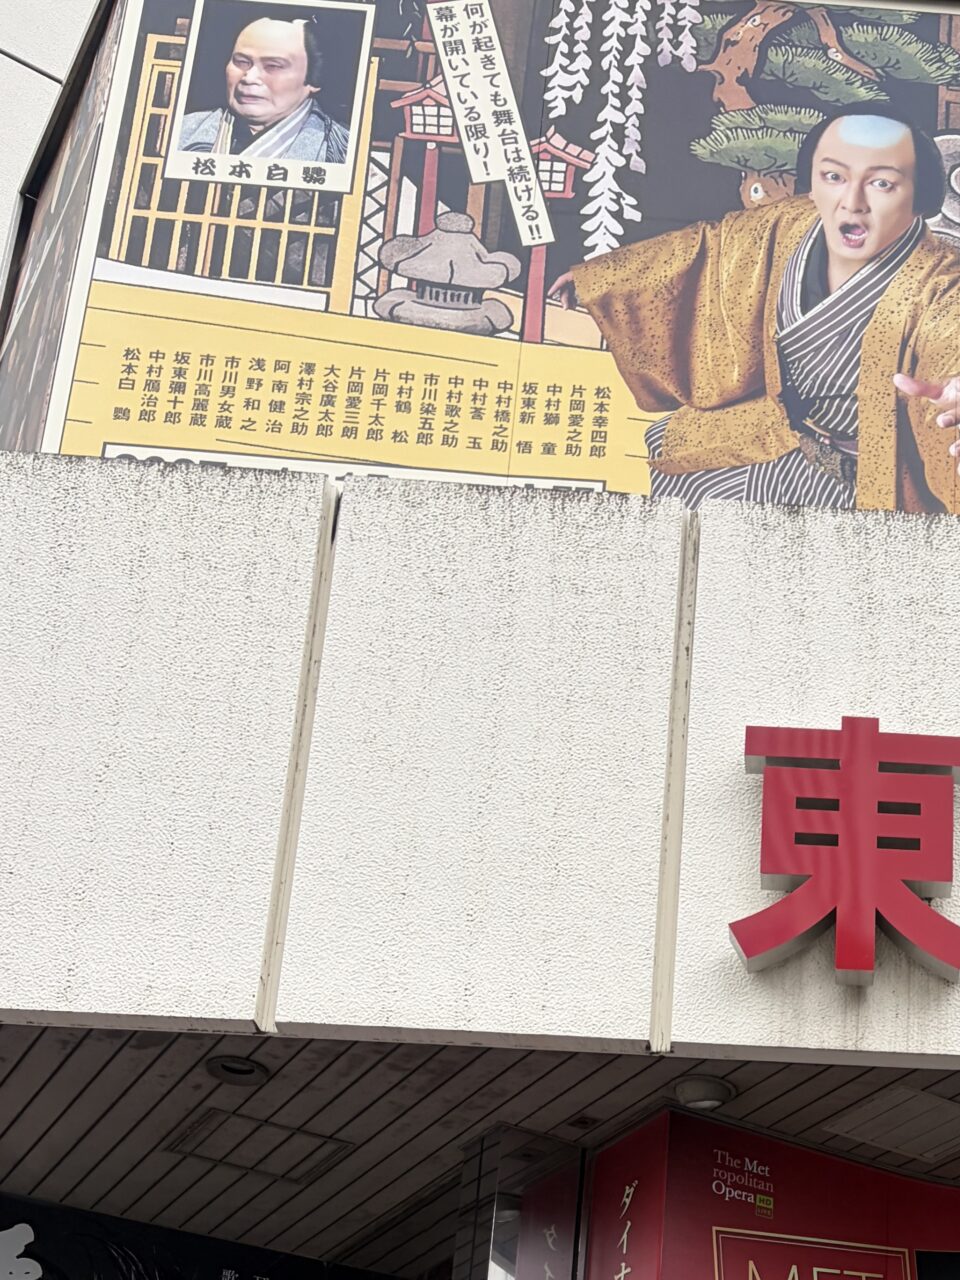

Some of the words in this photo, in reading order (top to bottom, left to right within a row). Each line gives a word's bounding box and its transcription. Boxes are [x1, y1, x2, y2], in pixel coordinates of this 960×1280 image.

[433, 6, 491, 176] 幕が開いている限り!
[214, 355, 241, 429] 市川男女蔵
[239, 357, 266, 432] 浅野和之
[265, 360, 291, 434] 阿南健治
[290, 361, 316, 436] 澤村宗之助
[366, 368, 391, 442] 片岡千太郎
[391, 370, 415, 444] 中村鶴松
[416, 373, 440, 446] 市川染五郎
[441, 375, 465, 448] 中村歌之助
[490, 380, 514, 453] 中村橋之助
[515, 382, 539, 454] 坂東新悟
[540, 384, 563, 456] 中村獅童
[564, 385, 587, 457] 片岡愛之助
[589, 386, 612, 459] 松本幸四郎
[712, 1180, 755, 1203] Opera
[713, 1149, 741, 1168] The
[744, 1157, 770, 1177] Met
[713, 1168, 774, 1192] ropolitan
